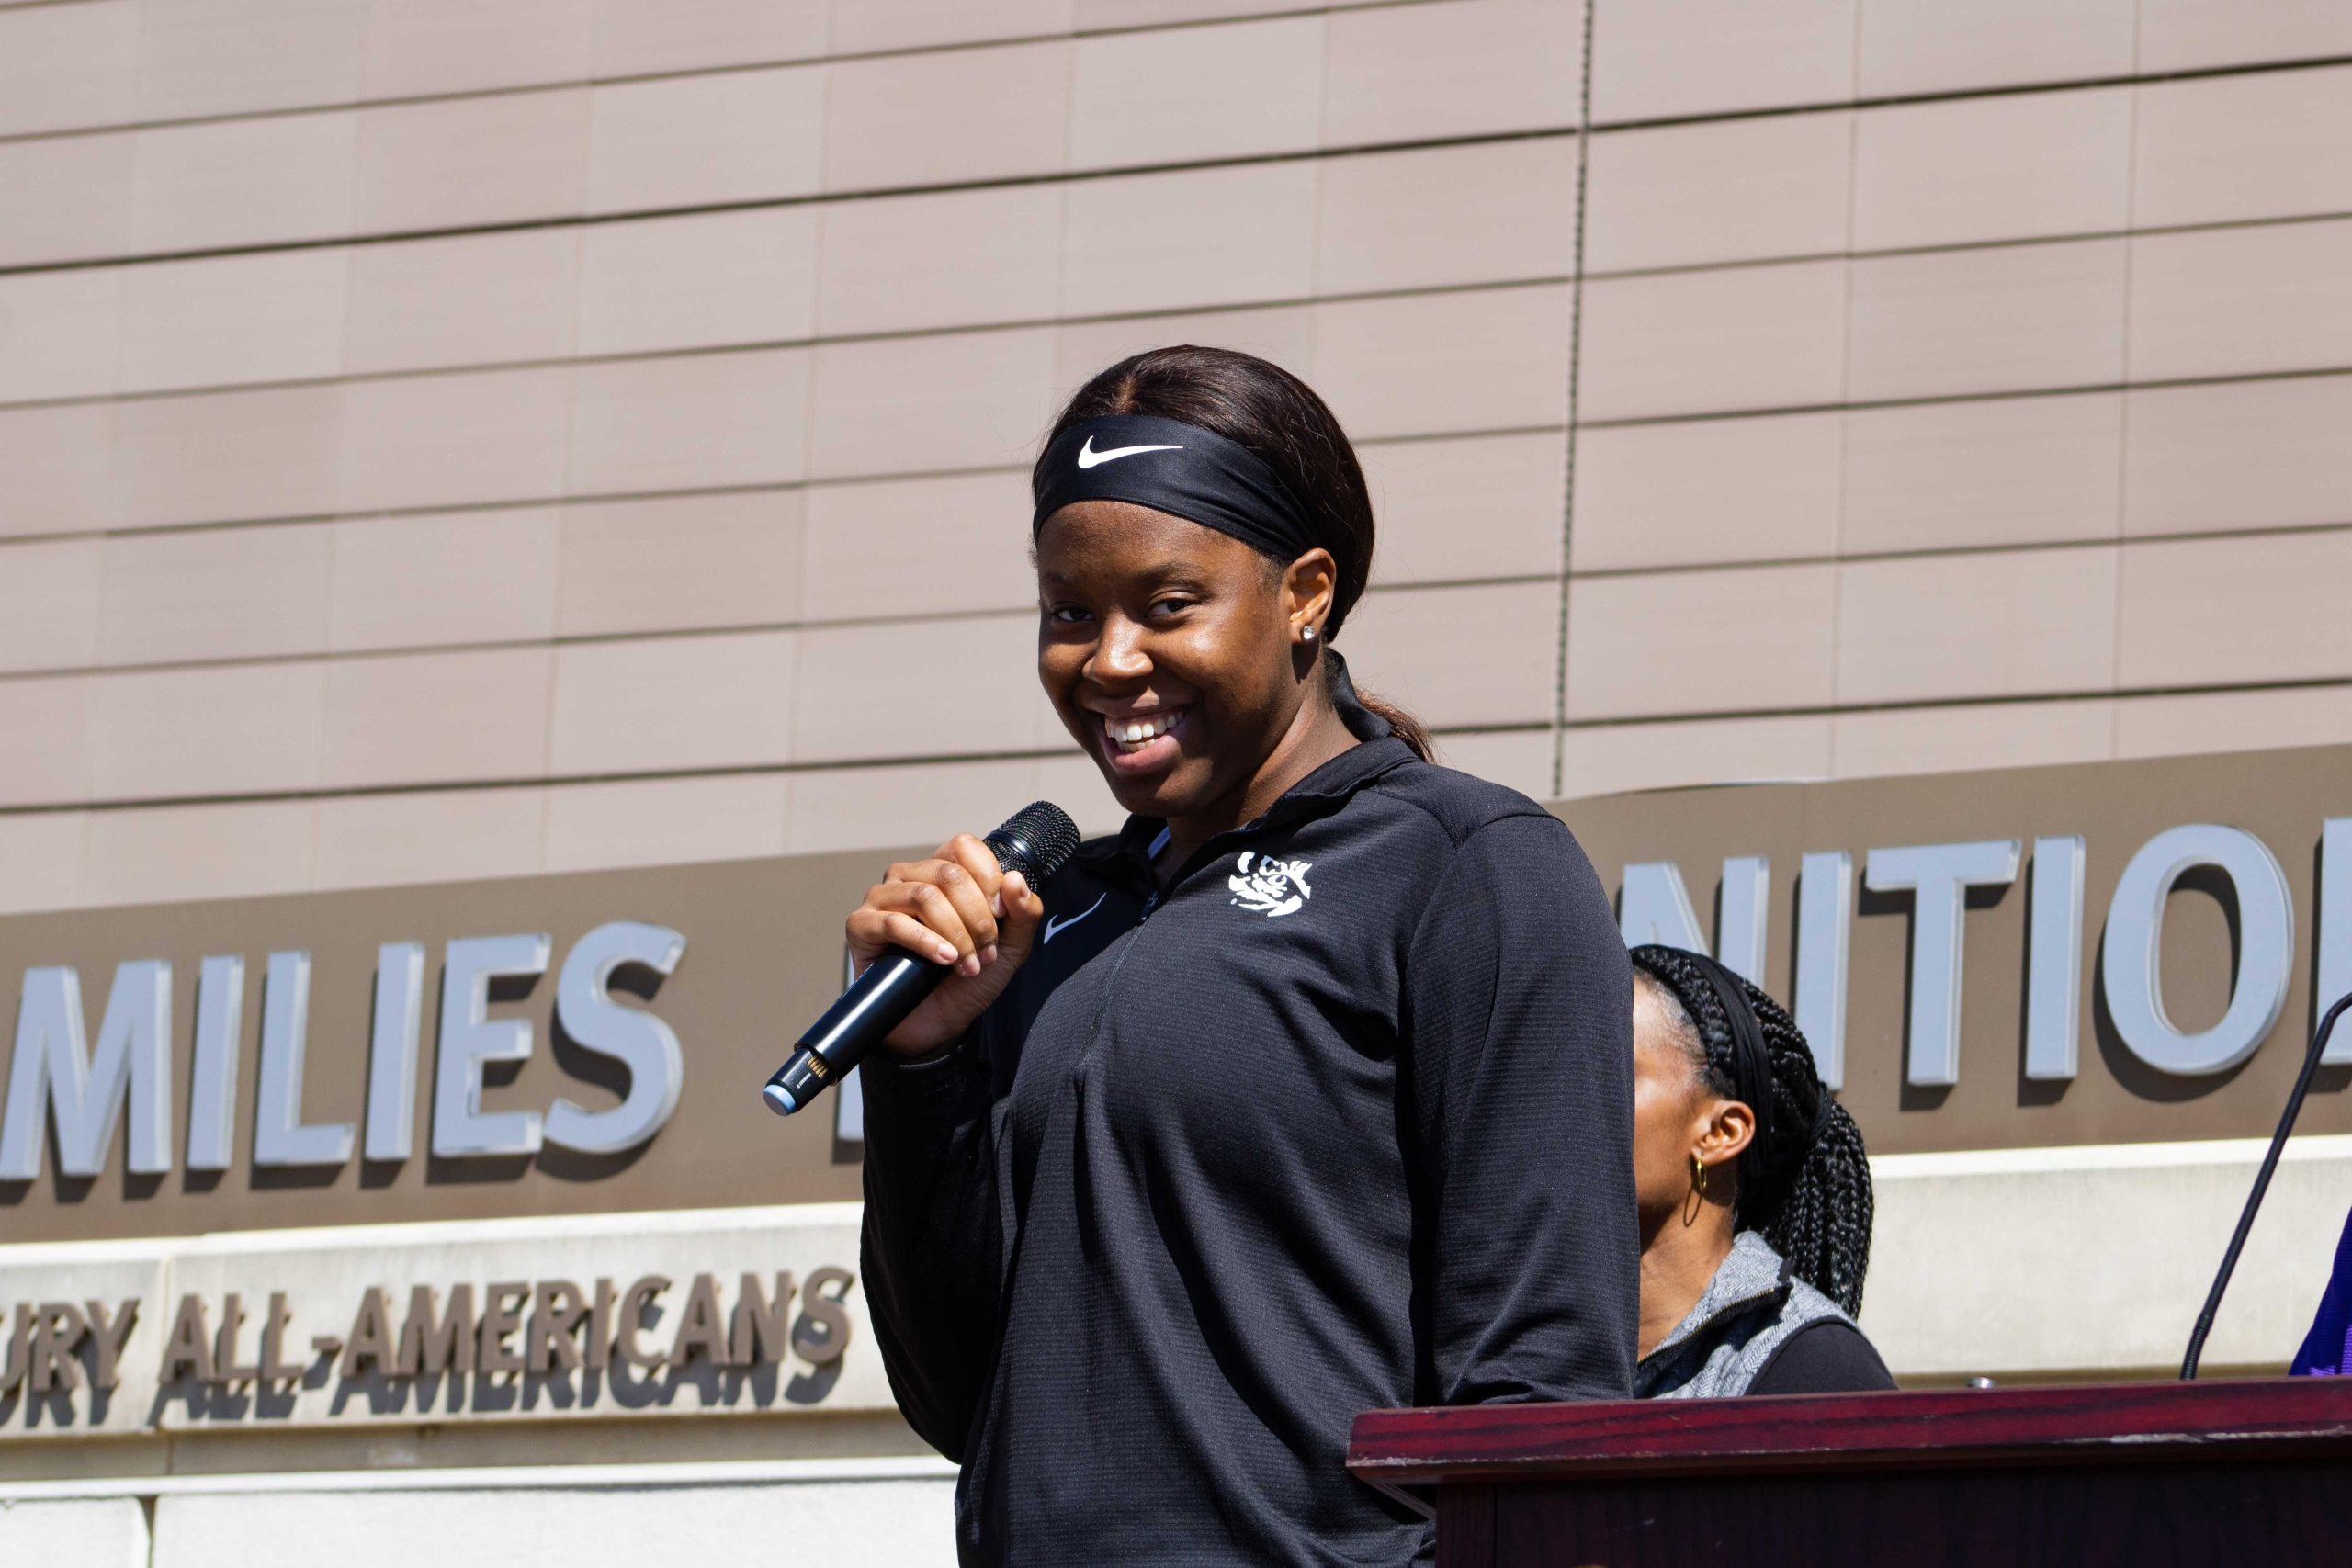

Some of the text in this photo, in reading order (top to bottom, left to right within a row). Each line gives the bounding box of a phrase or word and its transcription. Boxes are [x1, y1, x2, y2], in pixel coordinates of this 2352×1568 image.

[0, 920, 687, 1179] MILIES
[1620, 817, 2352, 1091] ITIO
[159, 1266, 855, 1382] ALL-AMERICANS
